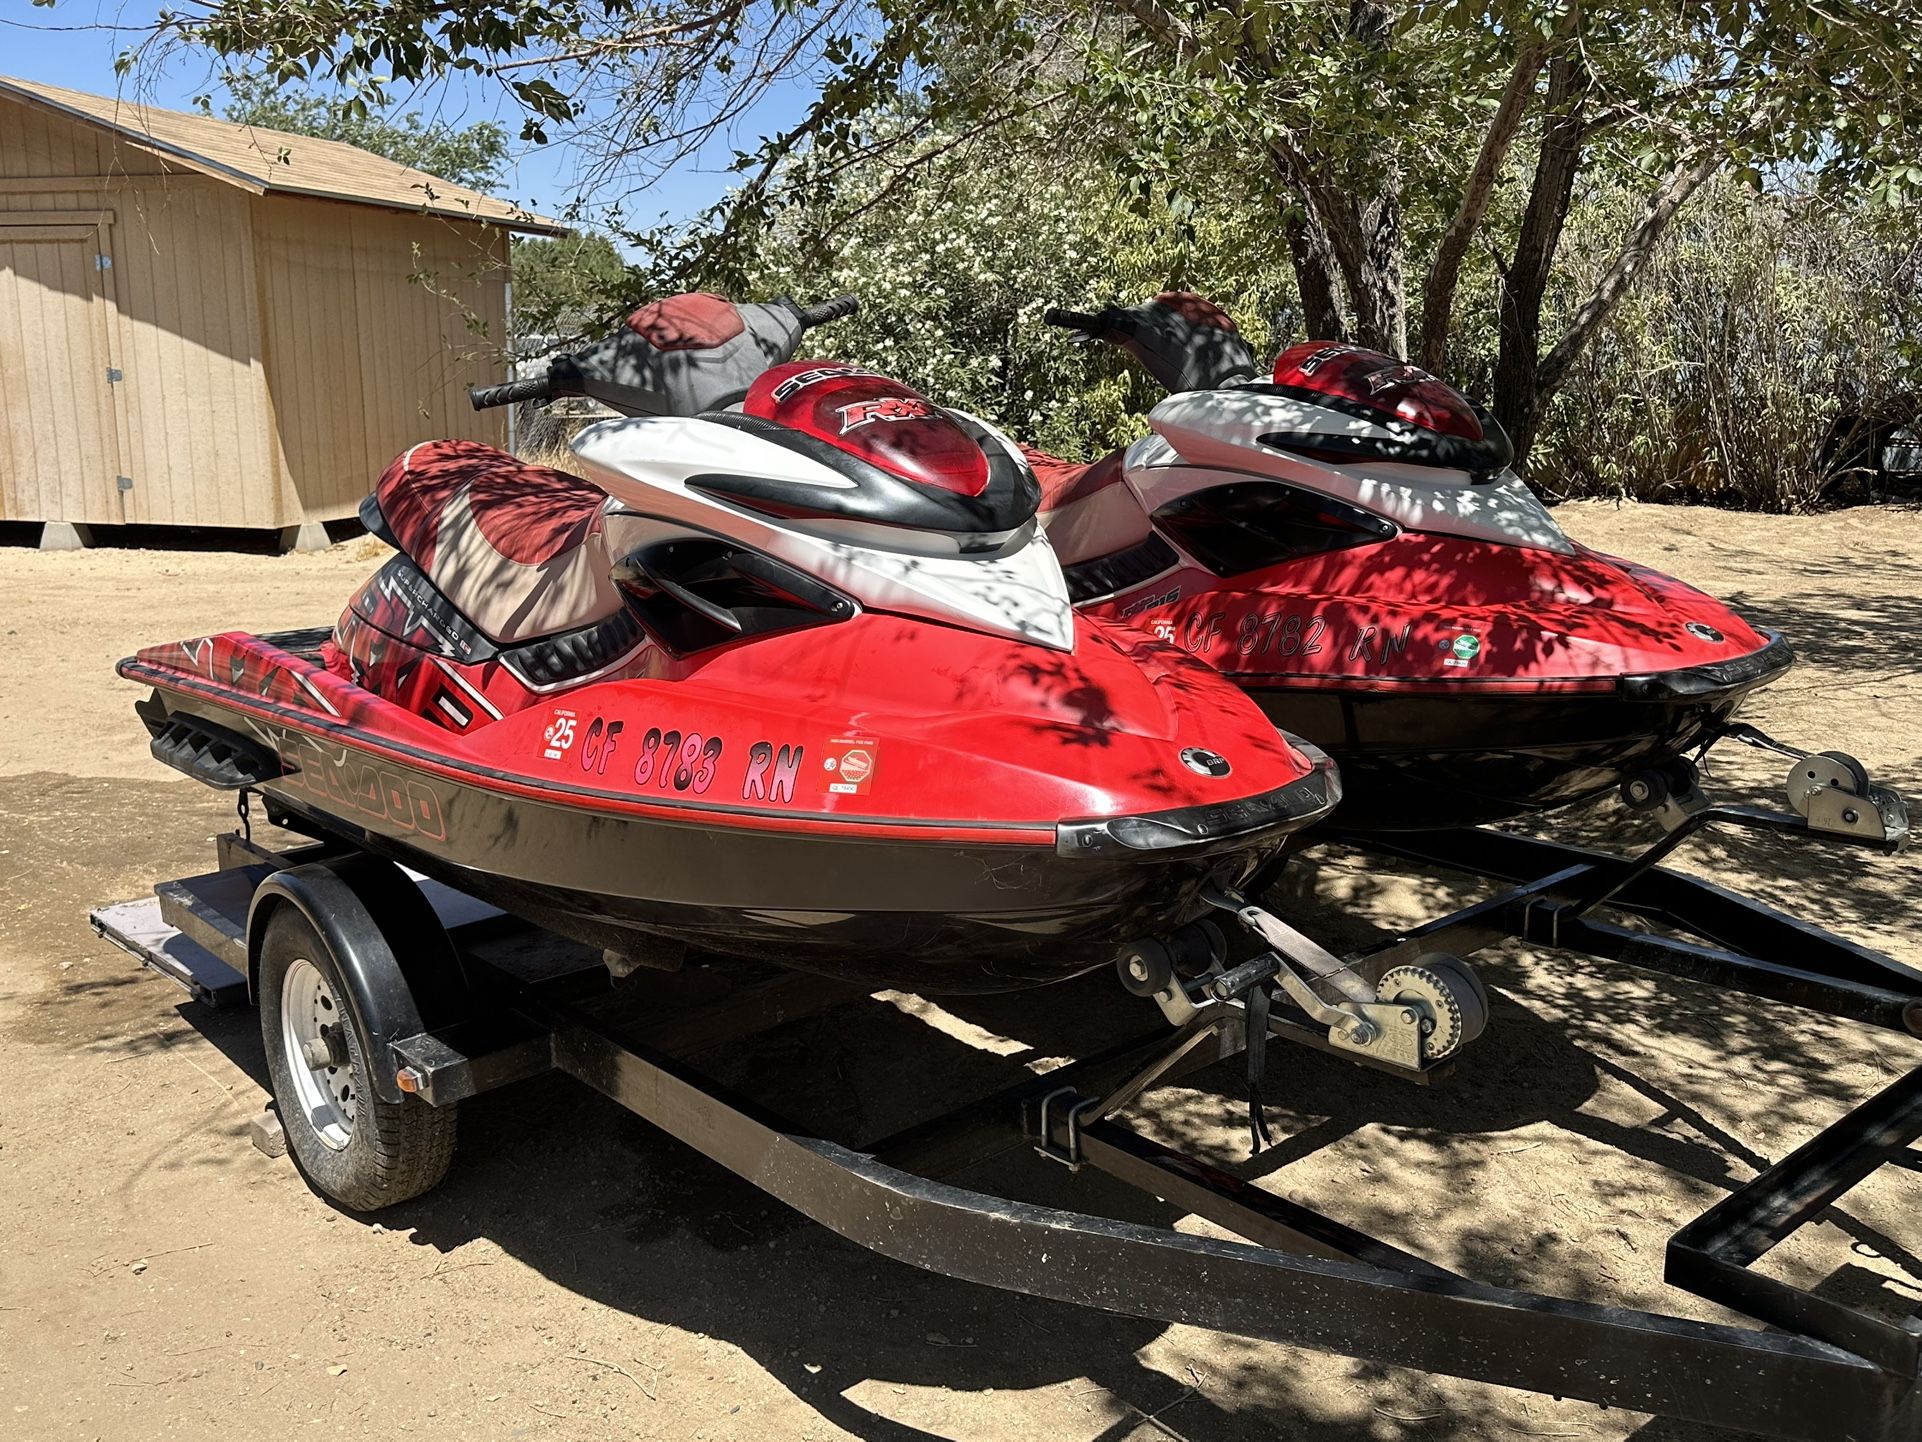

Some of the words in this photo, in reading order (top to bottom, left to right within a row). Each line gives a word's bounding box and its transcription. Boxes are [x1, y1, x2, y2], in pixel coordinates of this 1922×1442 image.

[1184, 612, 1226, 654] CF
[1237, 612, 1326, 657] 8782
[1349, 624, 1412, 665] RN
[549, 717, 578, 750] 25
[580, 717, 624, 775] CF
[634, 728, 723, 795] 8783
[742, 741, 804, 804] RN
